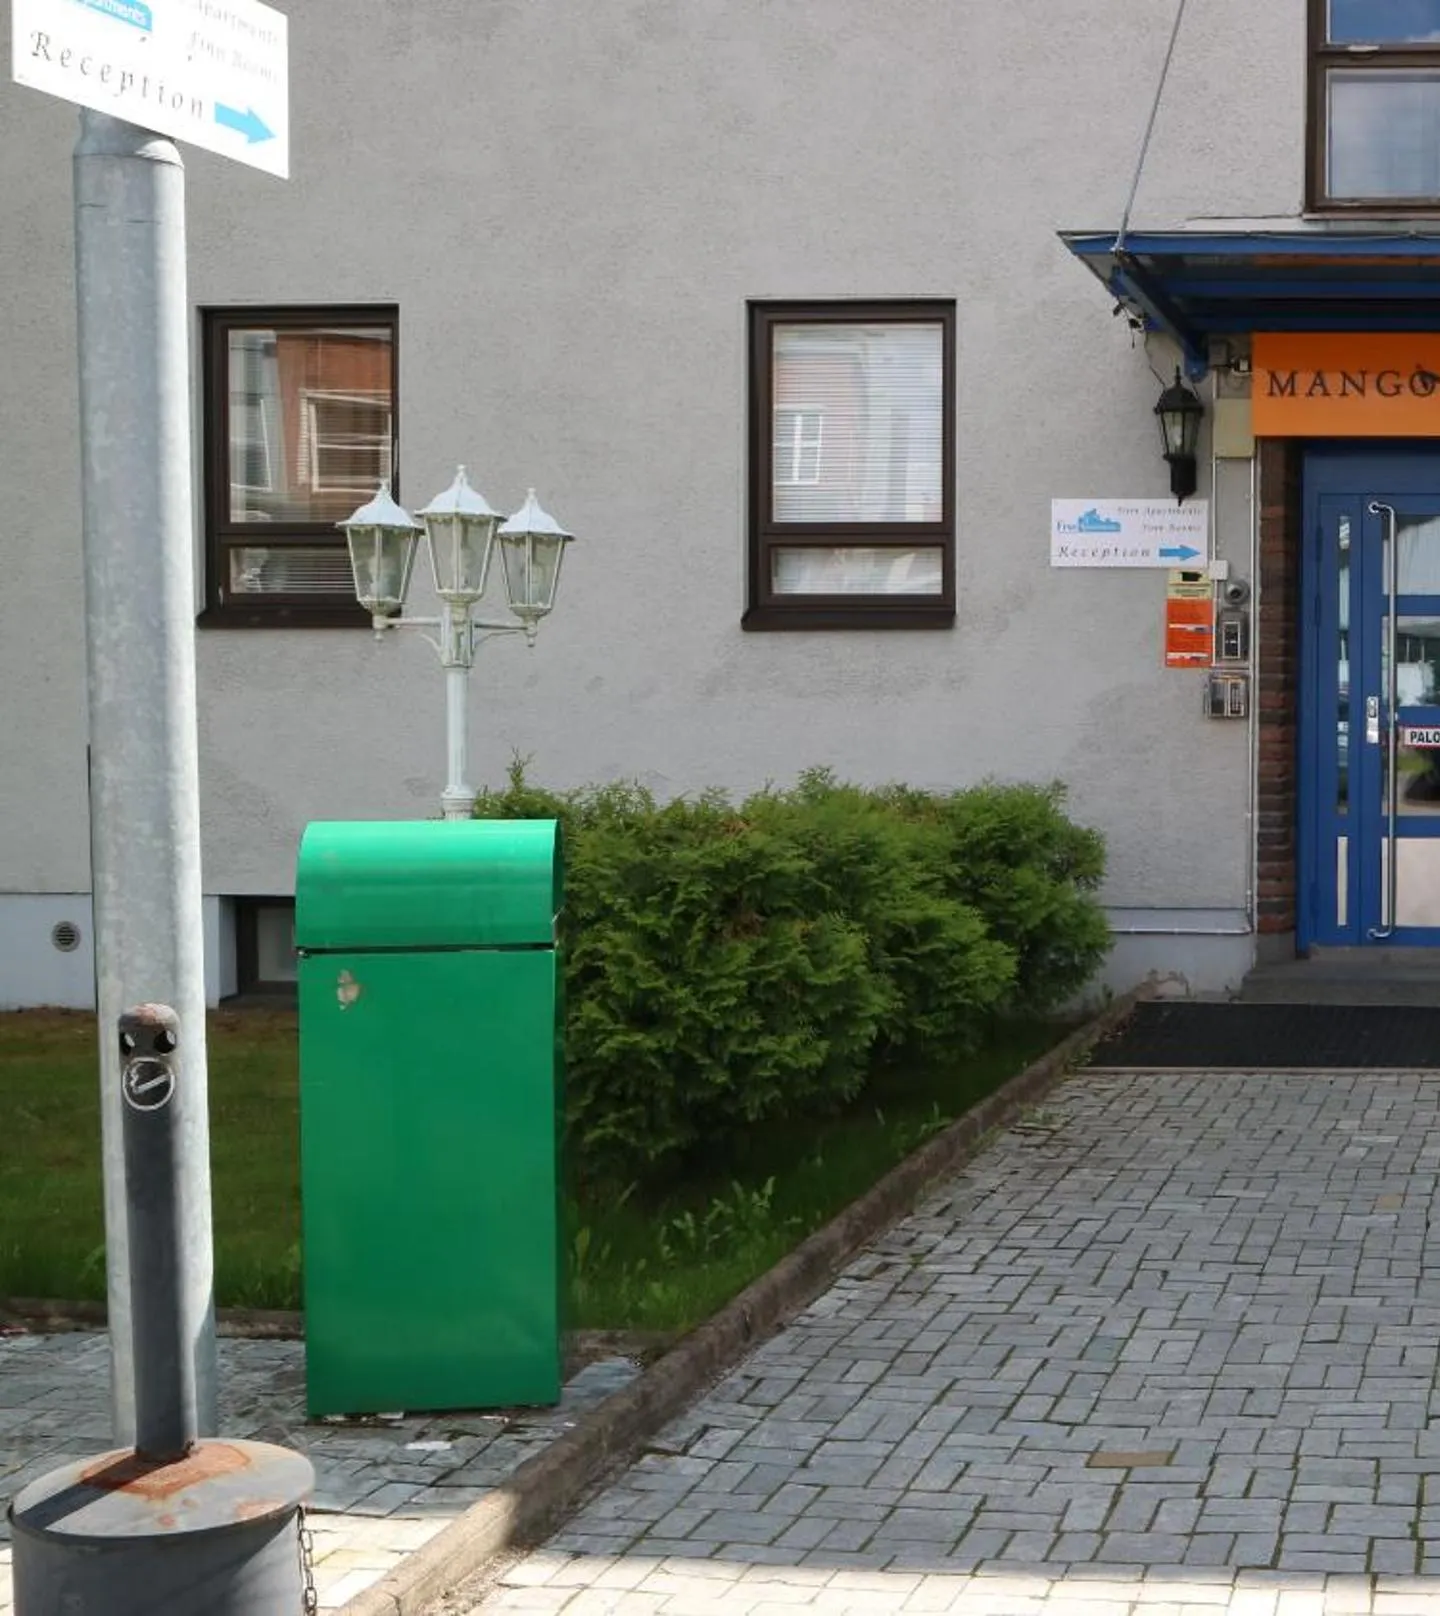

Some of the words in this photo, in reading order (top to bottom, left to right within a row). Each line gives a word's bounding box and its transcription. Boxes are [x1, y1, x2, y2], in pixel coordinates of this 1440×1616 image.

[30, 31, 204, 118] Reception
[1266, 368, 1438, 398] MANGO
[1058, 545, 1150, 559] Reception
